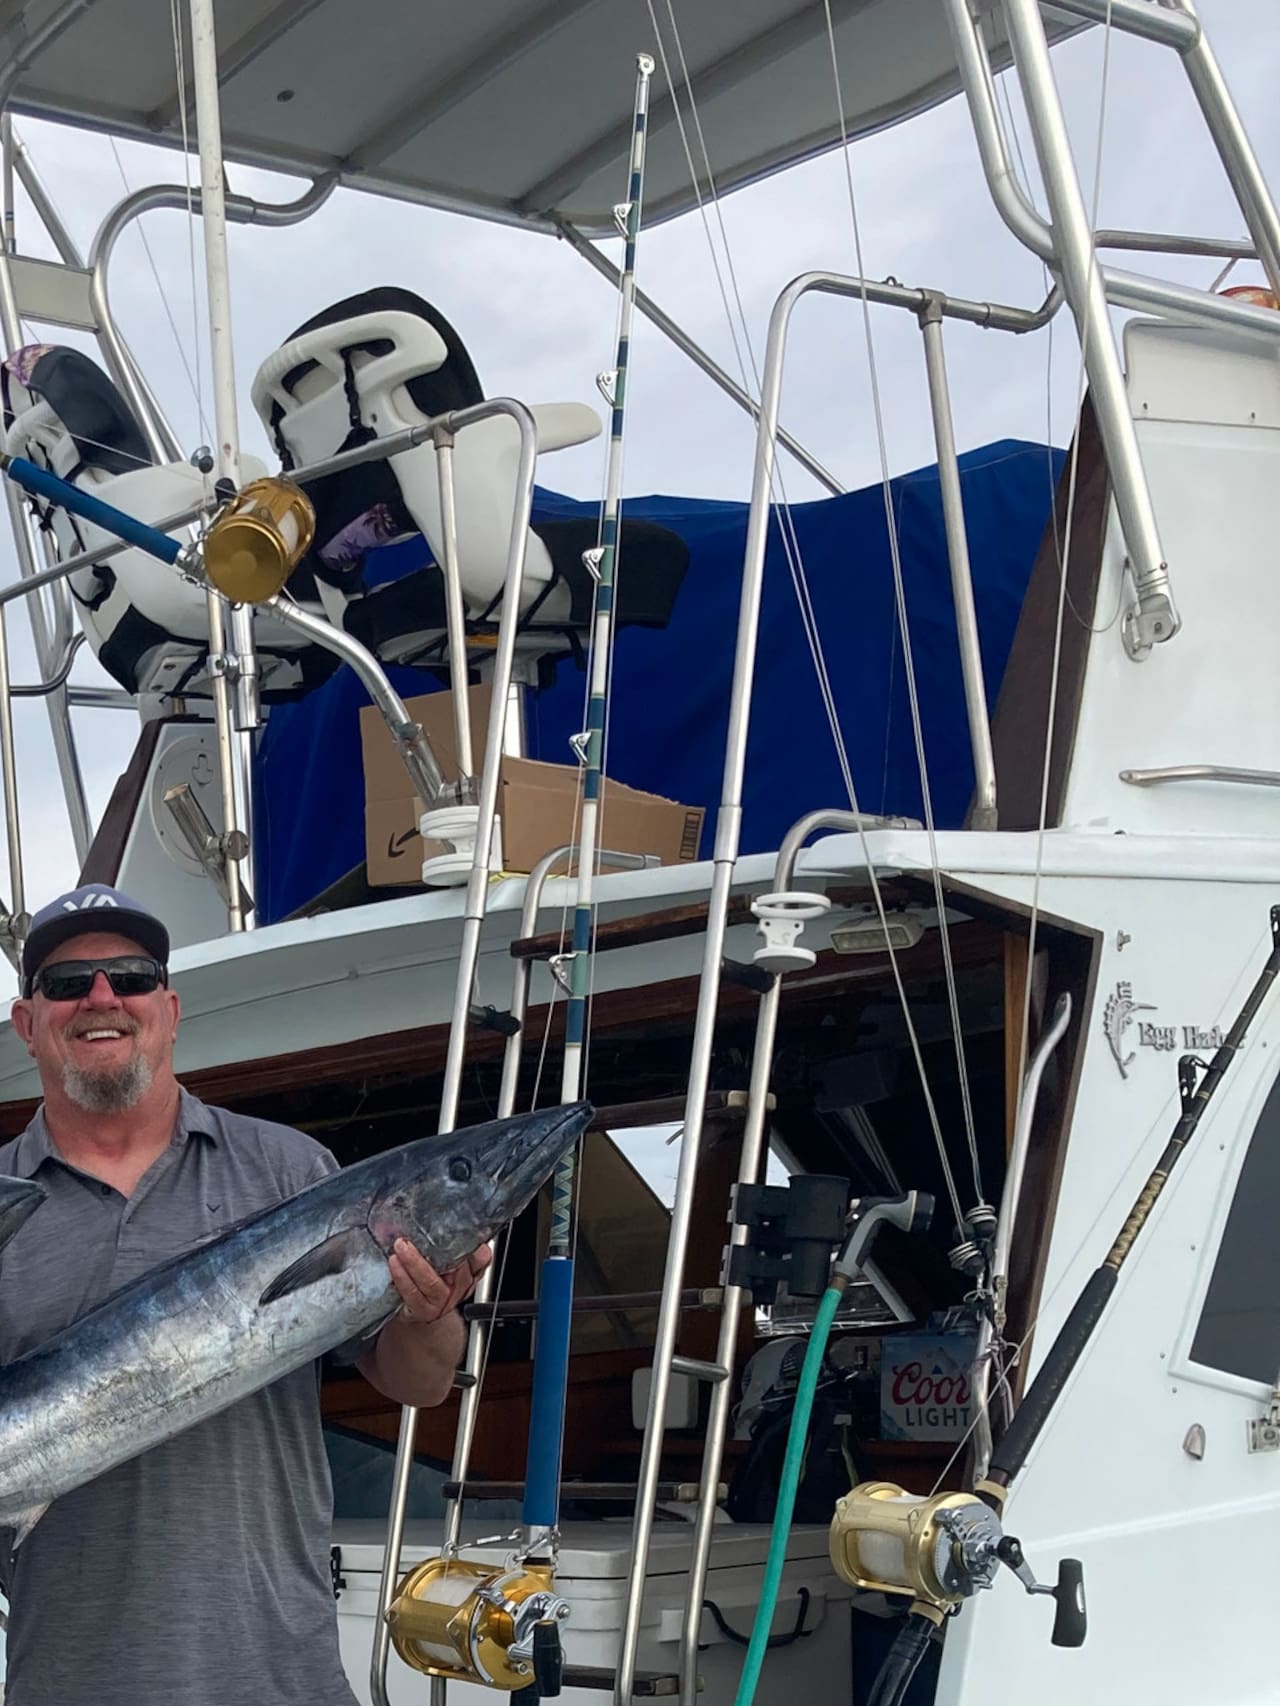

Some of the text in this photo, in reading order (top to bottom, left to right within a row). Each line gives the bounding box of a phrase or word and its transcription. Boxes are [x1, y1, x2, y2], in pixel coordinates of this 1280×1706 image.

[1137, 1022, 1177, 1051] Egg
[892, 1361, 970, 1405] Coor
[906, 1408, 970, 1427] LIGHT
